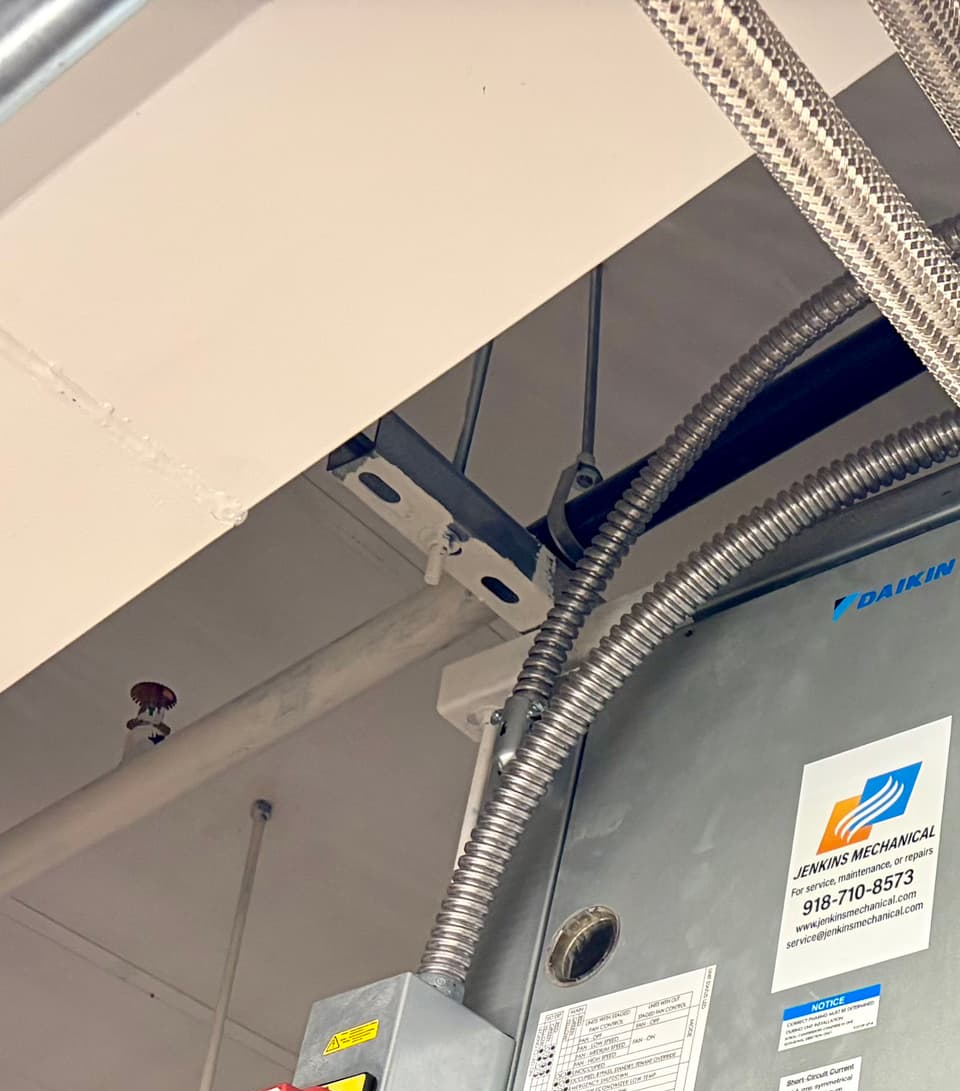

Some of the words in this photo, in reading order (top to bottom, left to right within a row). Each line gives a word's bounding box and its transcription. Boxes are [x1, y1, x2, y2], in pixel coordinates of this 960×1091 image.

[857, 558, 956, 610] DAIKIN
[791, 887, 804, 897] For
[805, 878, 837, 893] service,
[838, 860, 892, 883] maintenance,
[894, 857, 903, 866] or
[904, 847, 934, 862] repairs
[793, 853, 849, 880] JENKINS
[850, 825, 936, 863] MECHANICAL
[795, 890, 917, 933] www.jenkinsmechanical.com
[802, 868, 914, 916] 918-710-8573
[786, 901, 924, 949] service@jenkinsmechanical.com
[811, 996, 846, 1012] NOTICE
[830, 1064, 854, 1076] Current
